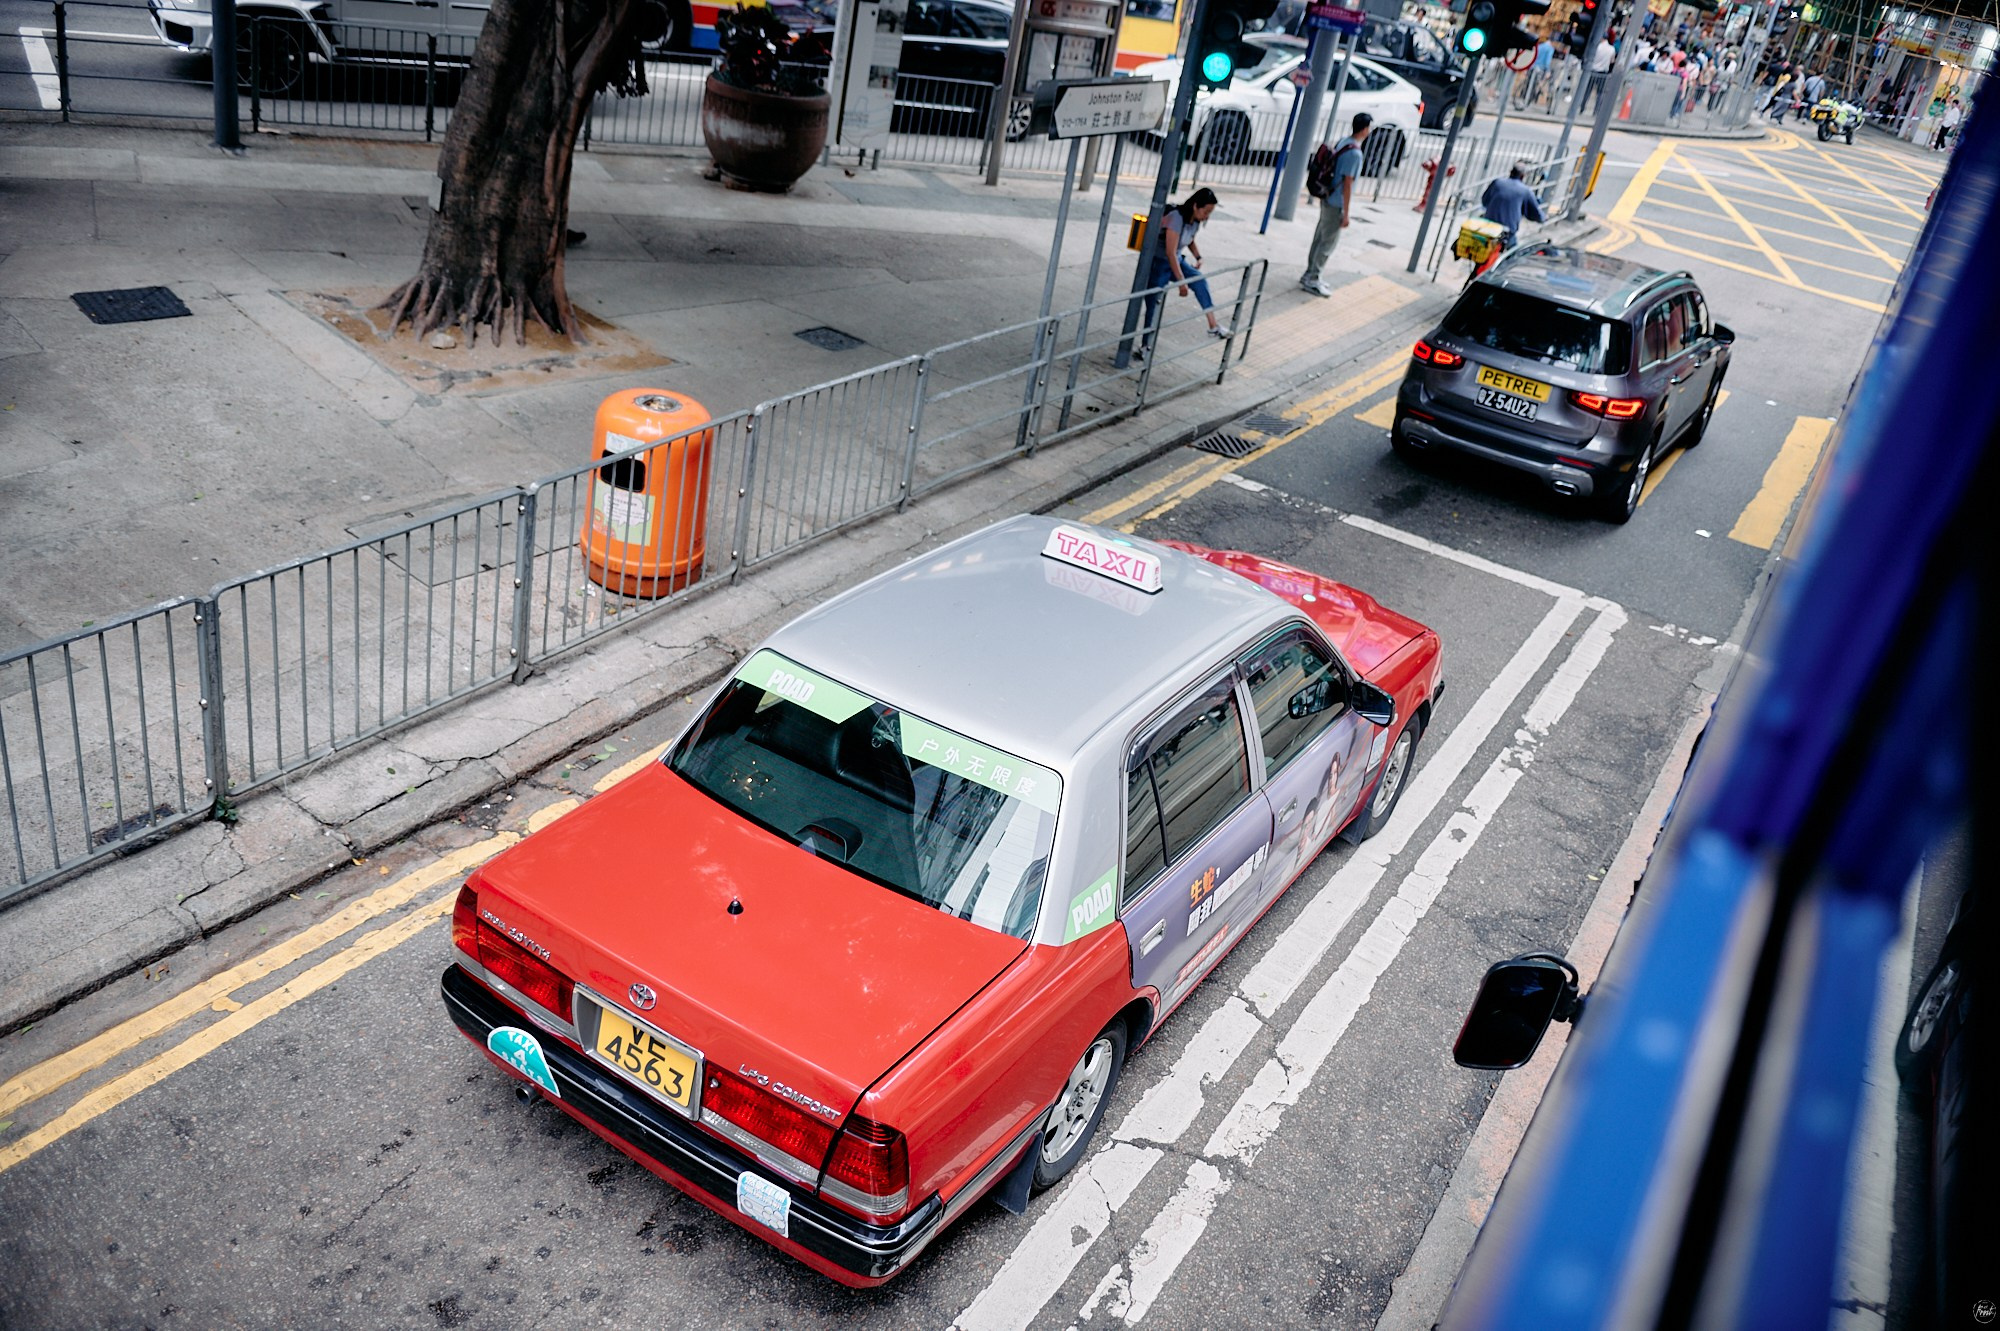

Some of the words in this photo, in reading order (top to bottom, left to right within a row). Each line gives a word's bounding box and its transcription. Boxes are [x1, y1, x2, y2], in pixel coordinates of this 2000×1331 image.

[1088, 92, 1122, 105] Johnston
[1124, 90, 1143, 104] Road
[1482, 369, 1542, 399] PETREL
[1057, 532, 1147, 583] TAXI
[766, 669, 816, 703] POAD
[918, 737, 1038, 798] 户外无限度
[1071, 881, 1113, 935] POAD
[508, 1031, 536, 1055] TAXI
[513, 1049, 528, 1066] 4
[632, 1025, 666, 1062] VE
[605, 1035, 684, 1099] 4563
[738, 1063, 769, 1086] LPG
[772, 1082, 841, 1121] COMFORT
